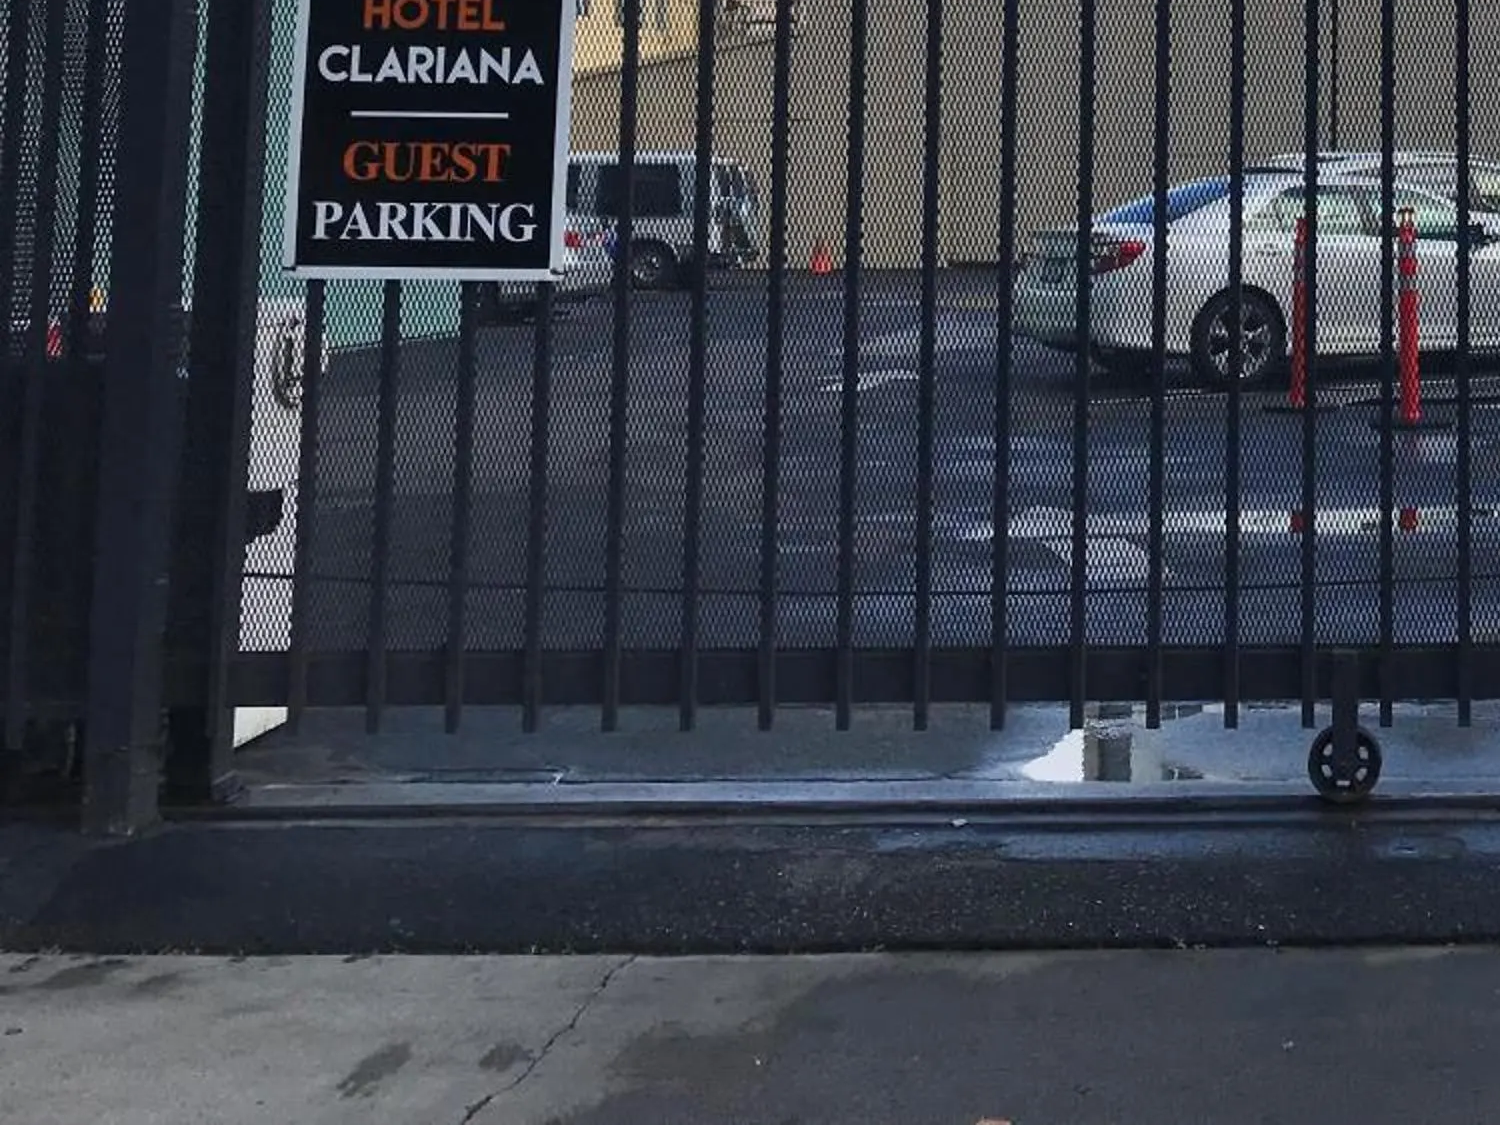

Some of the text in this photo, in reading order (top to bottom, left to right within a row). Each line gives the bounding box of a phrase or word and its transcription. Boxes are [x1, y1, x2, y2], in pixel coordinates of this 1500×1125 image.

[317, 44, 545, 86] CLARIANA
[342, 141, 511, 183] GUEST
[311, 201, 538, 243] PARKING
